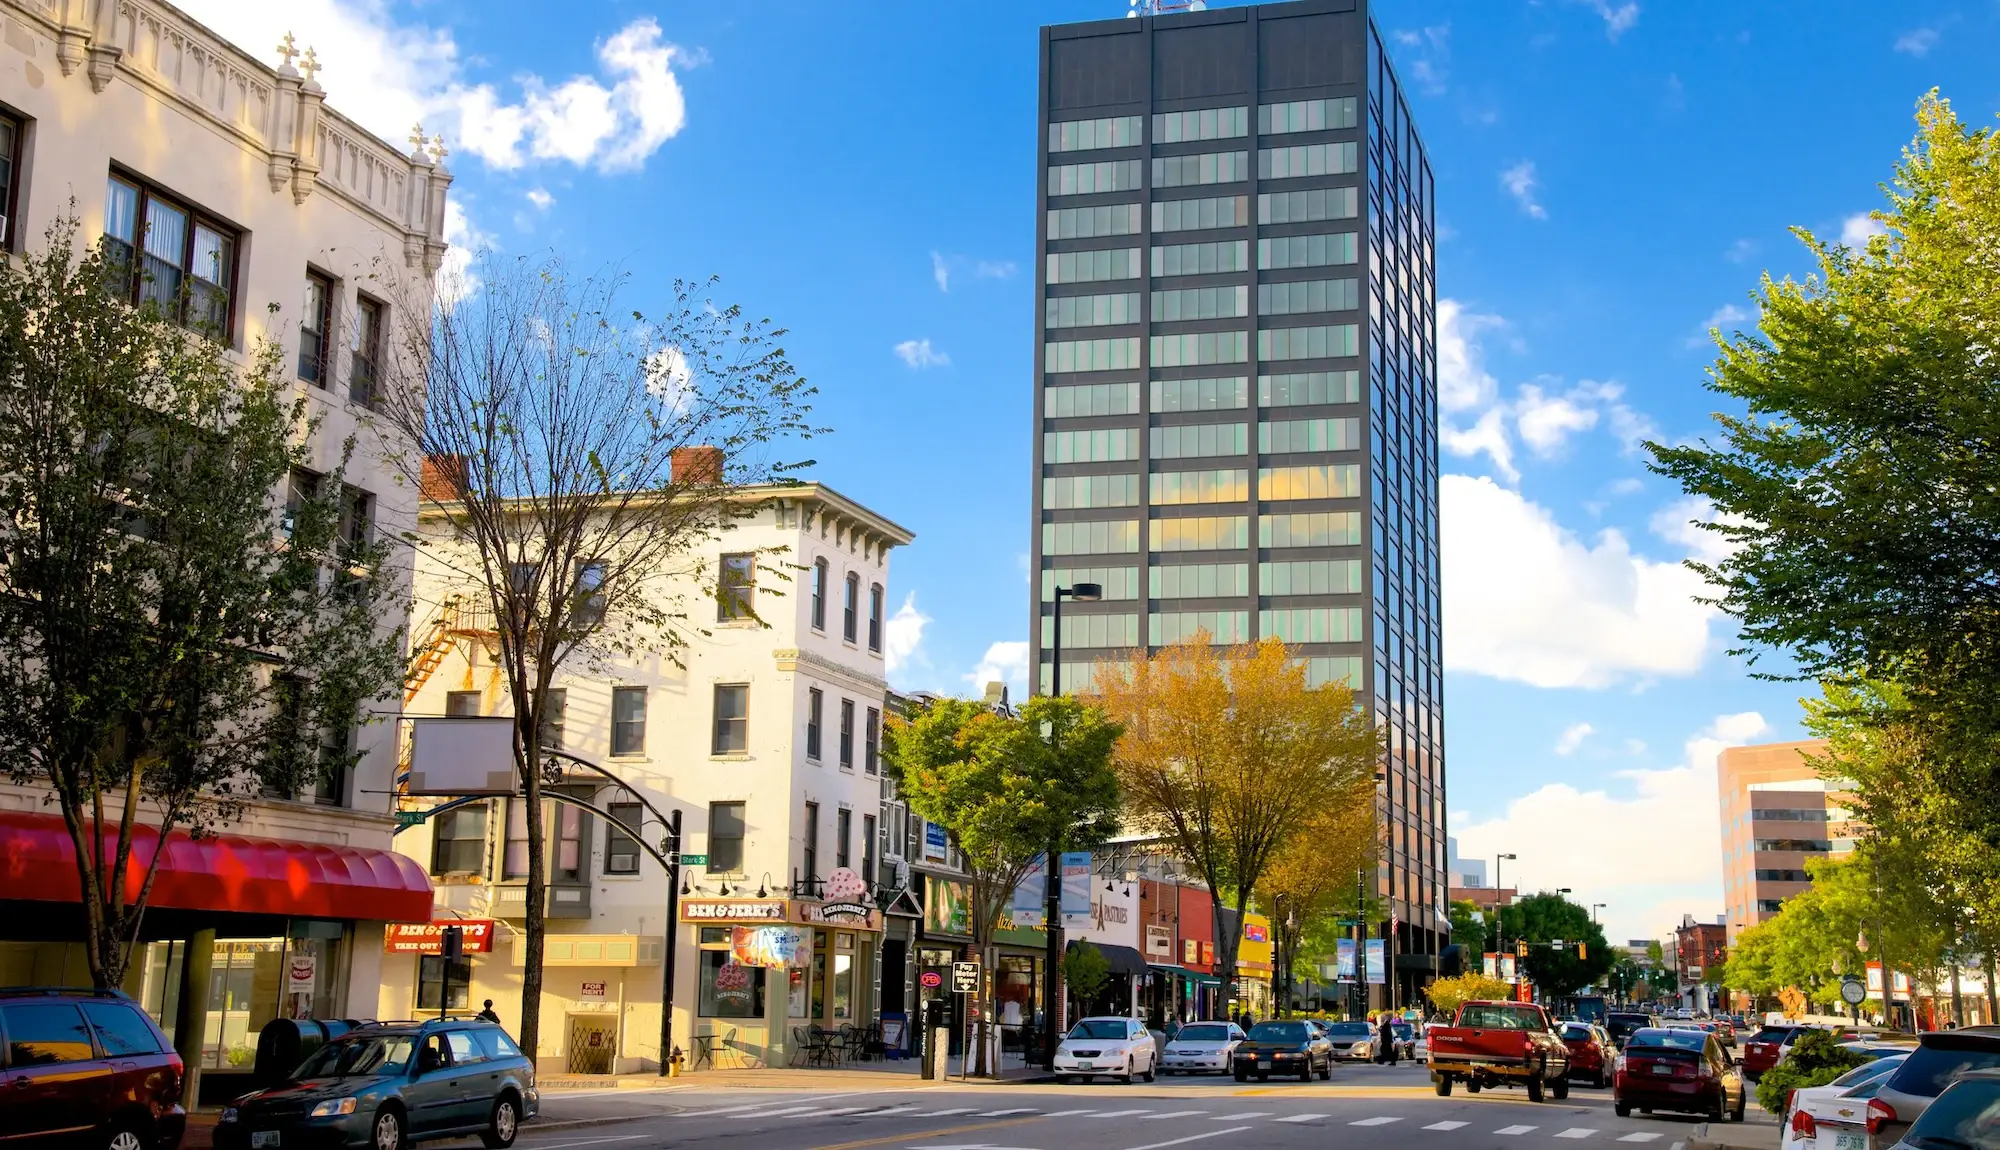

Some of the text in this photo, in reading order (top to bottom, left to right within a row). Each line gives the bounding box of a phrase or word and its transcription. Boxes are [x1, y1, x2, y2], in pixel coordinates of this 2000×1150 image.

[416, 813, 424, 823] St
[682, 856, 706, 864] Stark St
[1104, 904, 1128, 924] PASTRIES
[395, 942, 418, 950] TAKE
[419, 942, 438, 950] OUT
[960, 963, 973, 971] Pay
[922, 975, 939, 984] OPEN
[956, 976, 975, 984] Here
